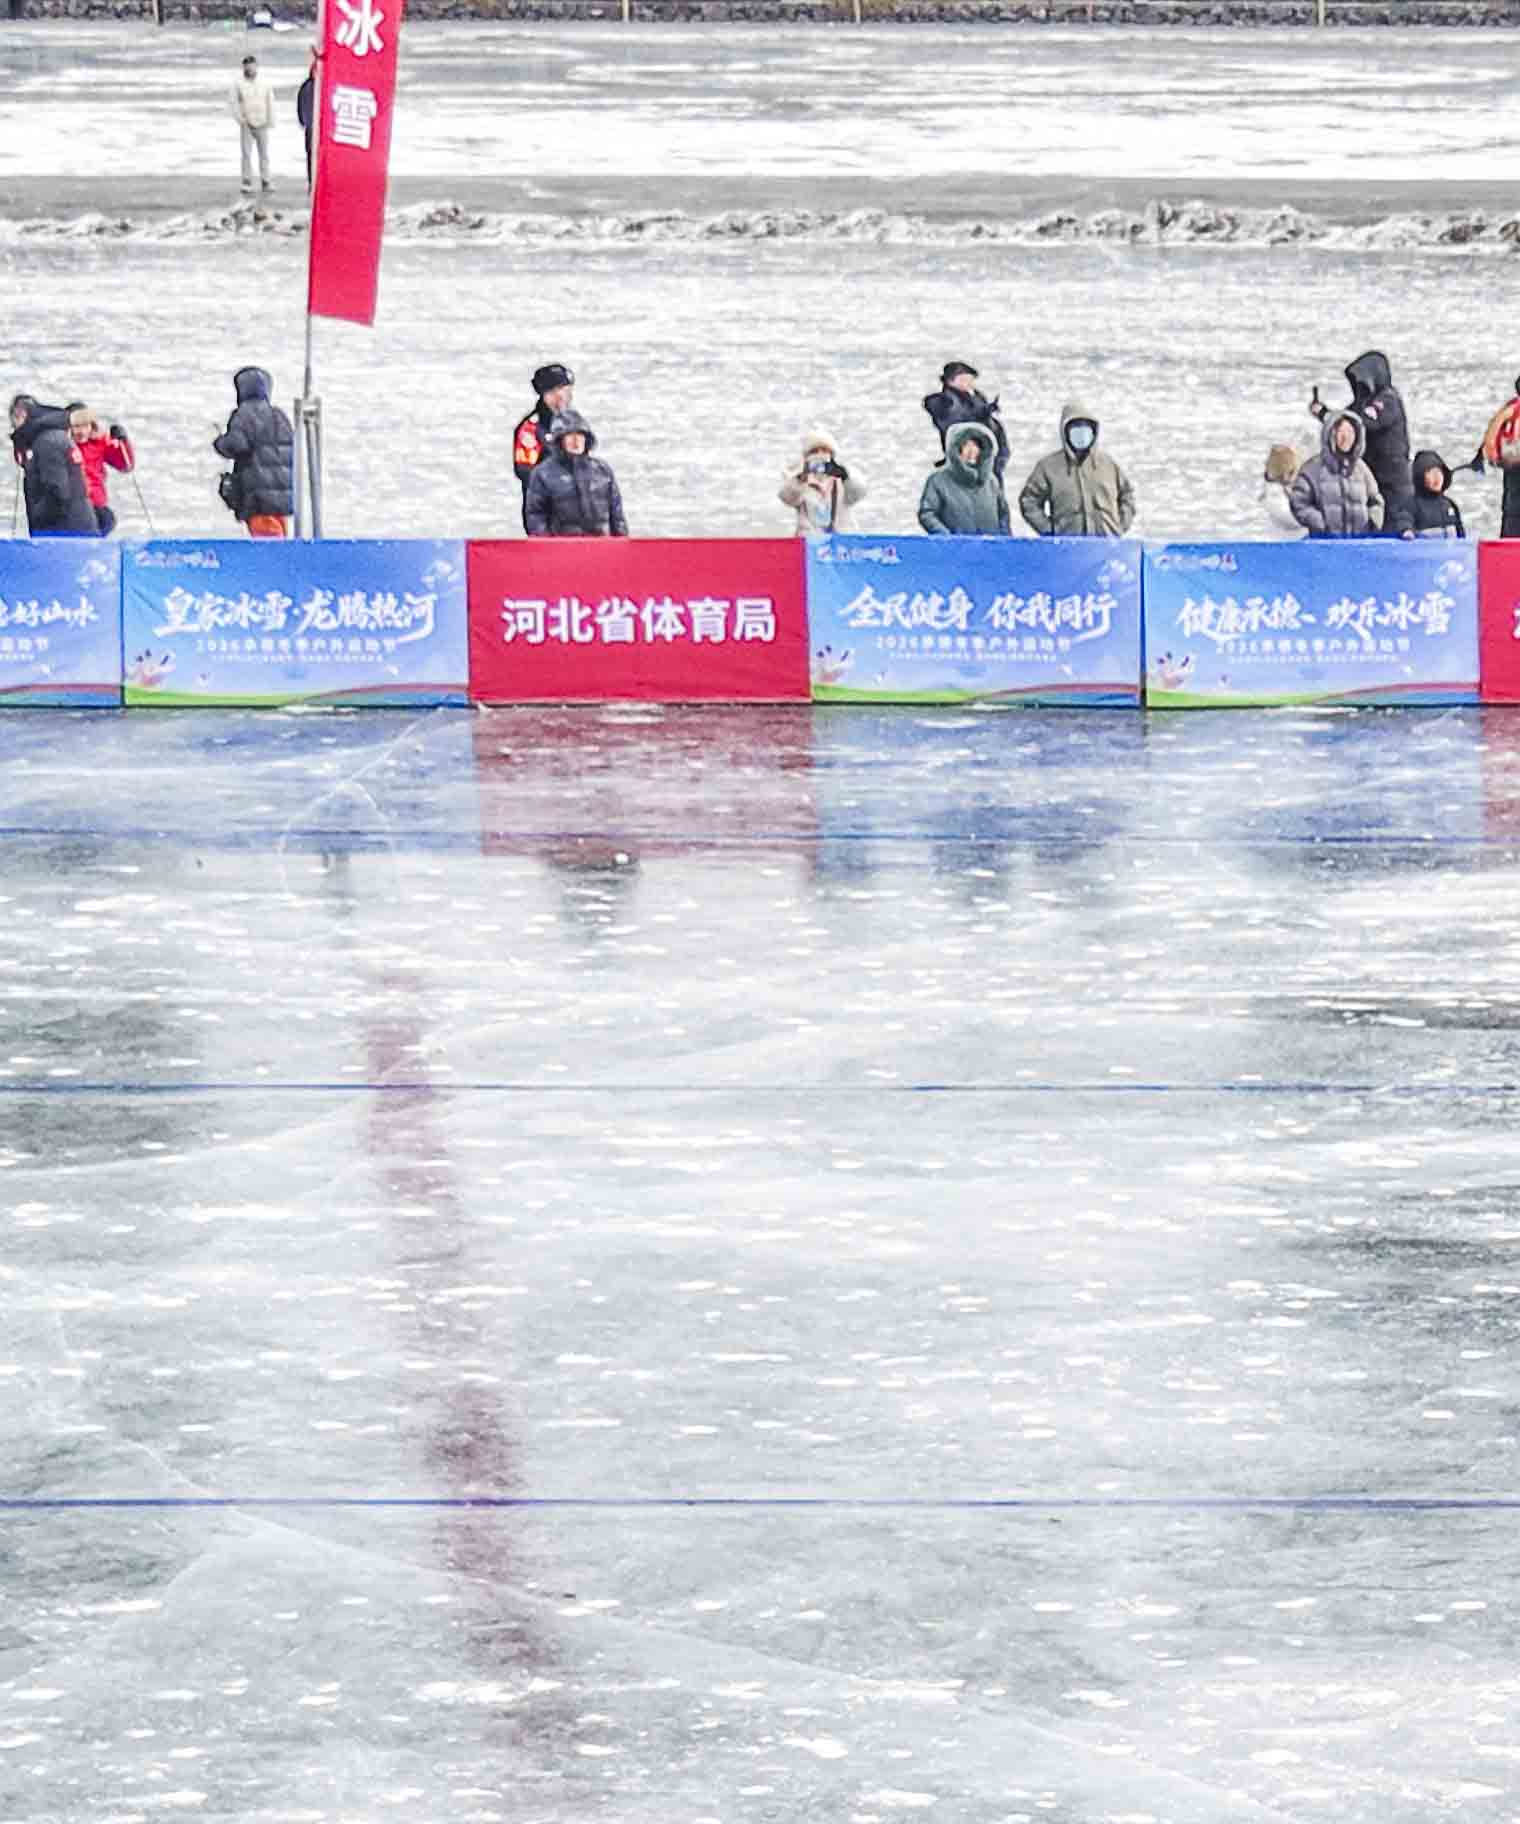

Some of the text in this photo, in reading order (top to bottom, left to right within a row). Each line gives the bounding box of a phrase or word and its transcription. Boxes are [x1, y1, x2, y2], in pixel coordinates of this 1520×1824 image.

[330, 0, 384, 149] 冰雪
[501, 598, 776, 643] 河北省体育局
[839, 585, 1118, 641] 全民健身 你我同行
